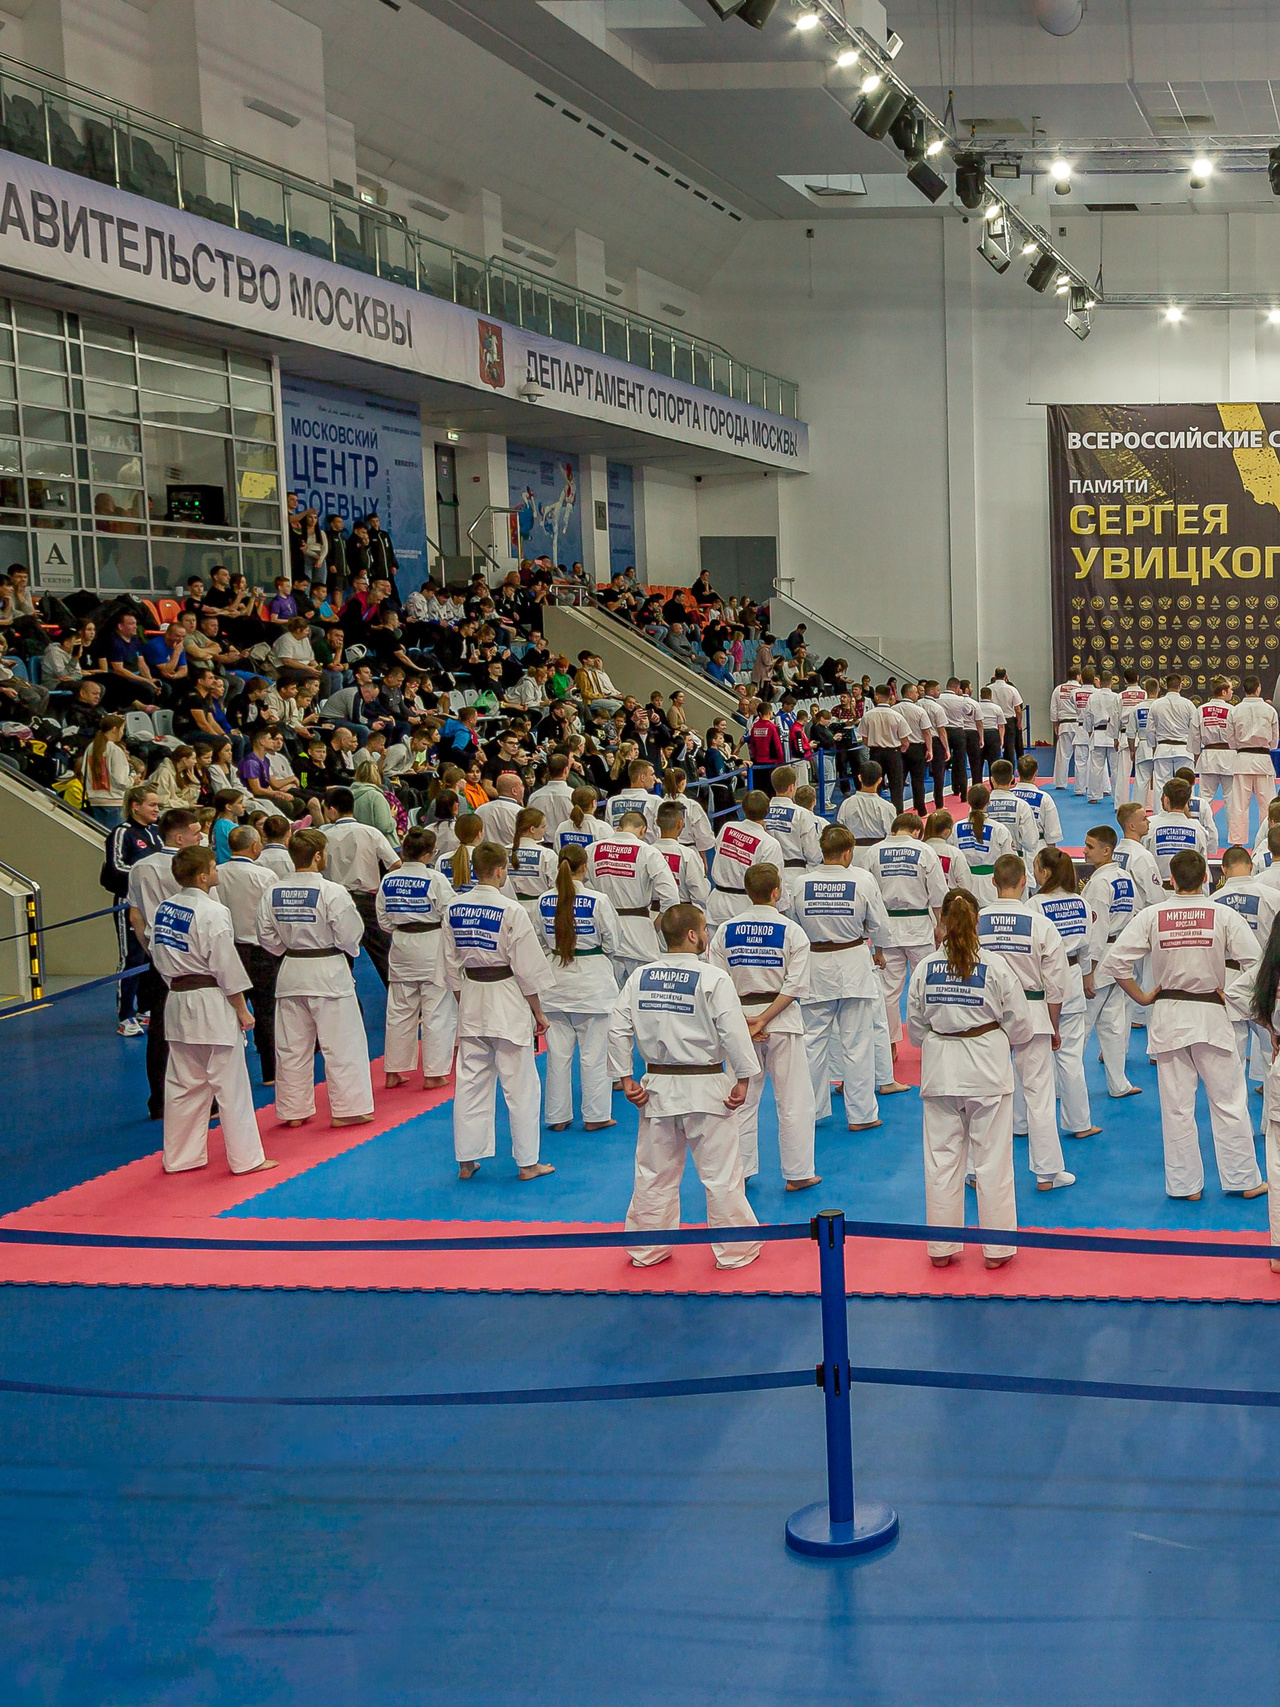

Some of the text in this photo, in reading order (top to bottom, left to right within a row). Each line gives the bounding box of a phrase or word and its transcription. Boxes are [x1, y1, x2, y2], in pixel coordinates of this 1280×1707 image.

[289, 271, 412, 349] МОСКВЫ
[527, 350, 798, 457] ДЕПАРТАМЕНТ СПОРТА ГОРОДА МОСКВЫ
[291, 417, 379, 449] МОСКОВСКИЙ
[1067, 426, 1263, 450] ВСЕРОССИЙСКИЕ
[291, 443, 379, 490] ЦЕНТР
[1068, 479, 1148, 494] ПАМЯТИ
[293, 488, 379, 522] БОЕВЫХ
[1069, 503, 1228, 536] СЕРГЕЯ
[44, 542, 68, 565] А
[42, 577, 72, 585] СЕКТОР
[385, 879, 426, 888] ГЛУХОВСКАЯ
[813, 883, 846, 892] ВОРОНОВ
[281, 890, 309, 898] ПОЛЯКОВ
[990, 915, 1017, 925] КУПИН
[1166, 910, 1205, 921] МИТЯШИН
[735, 924, 774, 935] КОТЮКОВ
[993, 925, 1014, 933] ДАНИЛА
[1175, 919, 1197, 927] ЯРОСЛАВ
